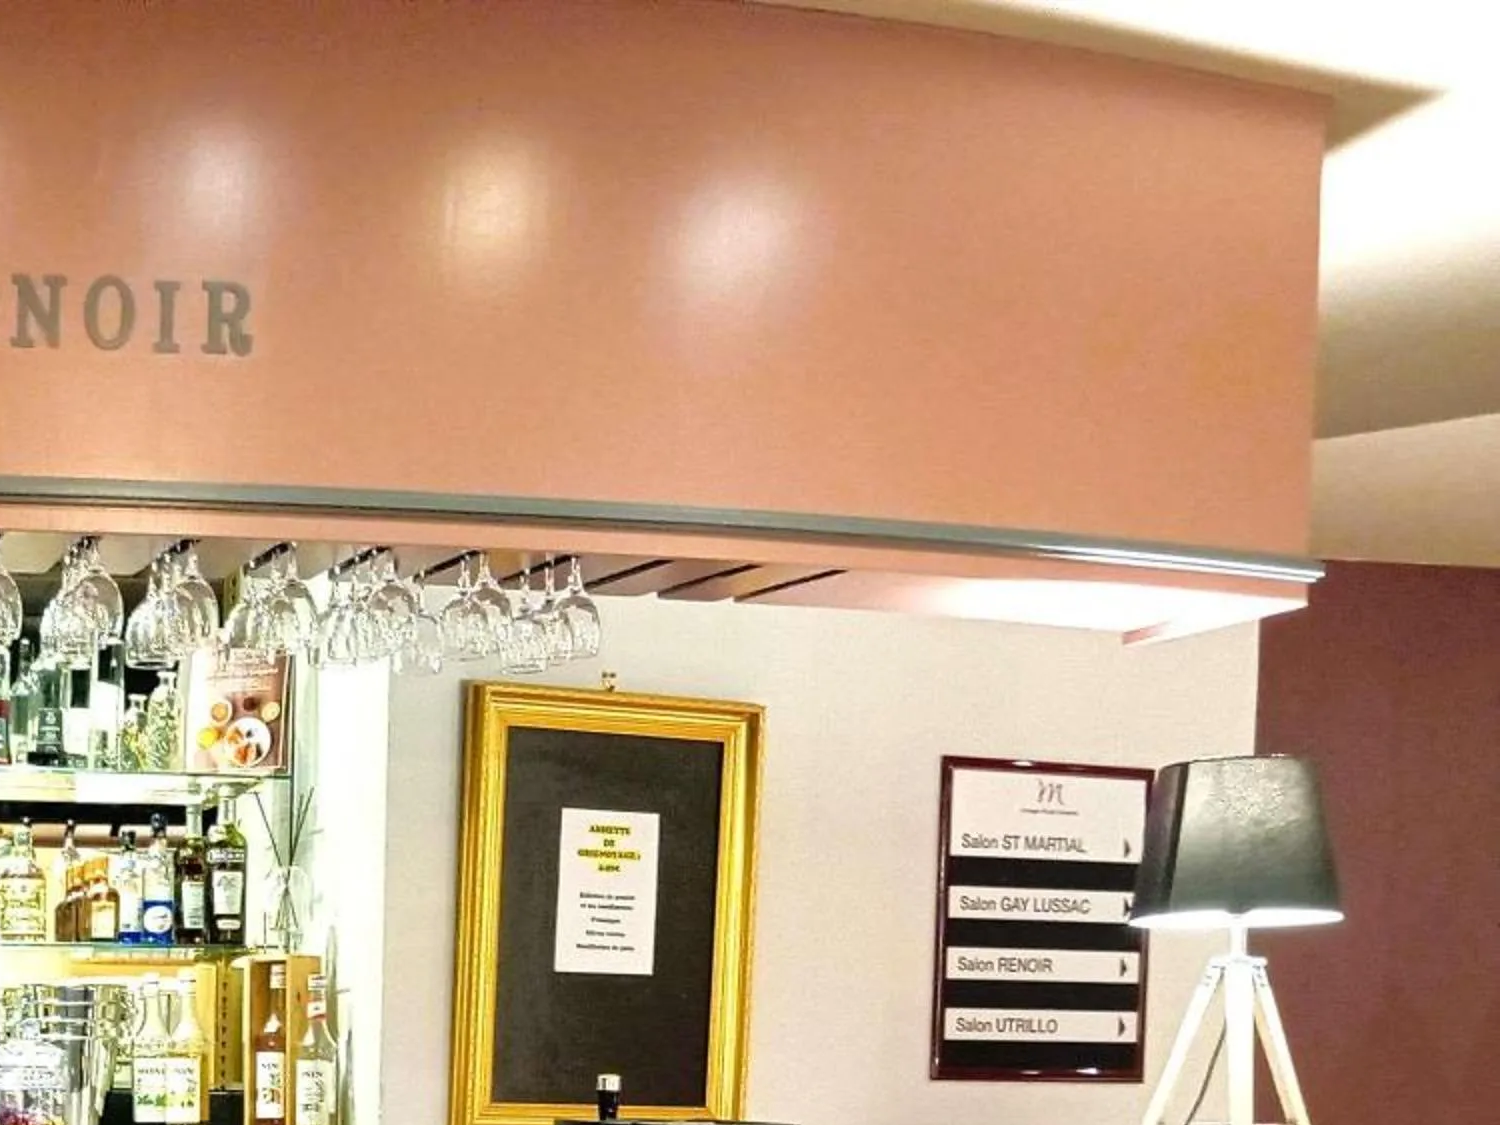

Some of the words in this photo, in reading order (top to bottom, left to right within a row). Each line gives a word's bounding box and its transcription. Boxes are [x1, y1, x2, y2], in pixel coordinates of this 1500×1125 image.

[961, 833, 999, 849] Salon
[1001, 835, 1021, 850] ST
[1023, 835, 1088, 853] MARTIAL
[959, 895, 997, 911] Salon
[1000, 895, 1030, 912] GAY
[1033, 897, 1092, 914] LUSSAC
[956, 956, 995, 972] Salon
[997, 957, 1054, 973] RENOIR
[955, 1017, 993, 1032] Salon
[995, 1017, 1059, 1034] UTRILLO
